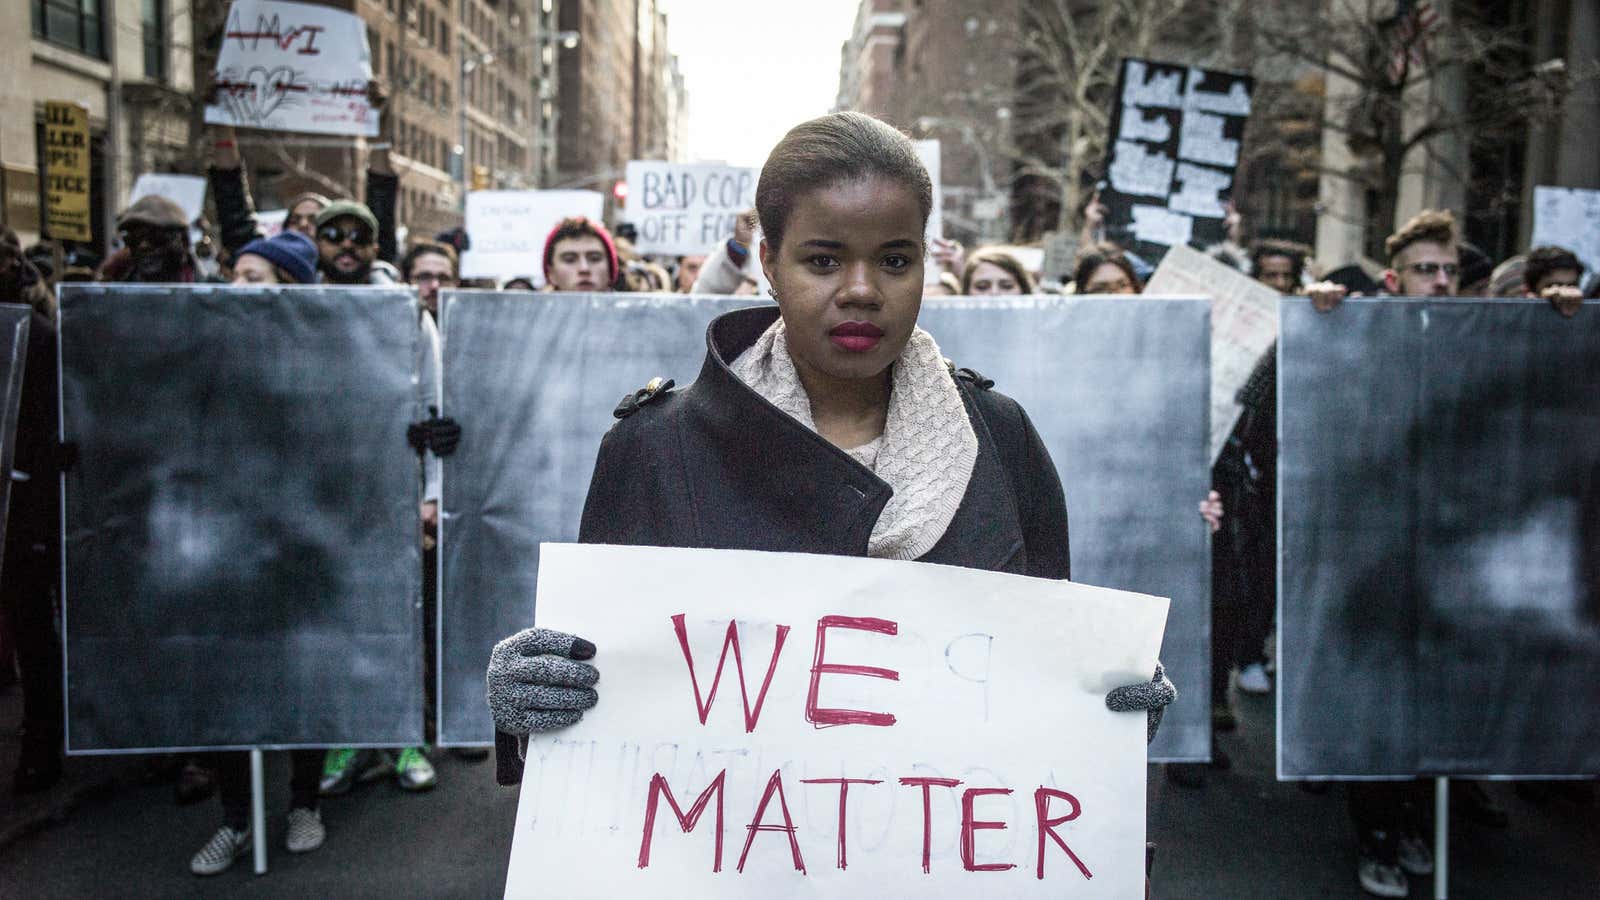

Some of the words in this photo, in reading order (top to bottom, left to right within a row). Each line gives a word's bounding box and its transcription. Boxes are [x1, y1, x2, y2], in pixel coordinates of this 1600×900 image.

[642, 170, 697, 209] BAD
[641, 213, 687, 243] OFF
[672, 613, 900, 734] WE
[639, 771, 1093, 881] MATTER
